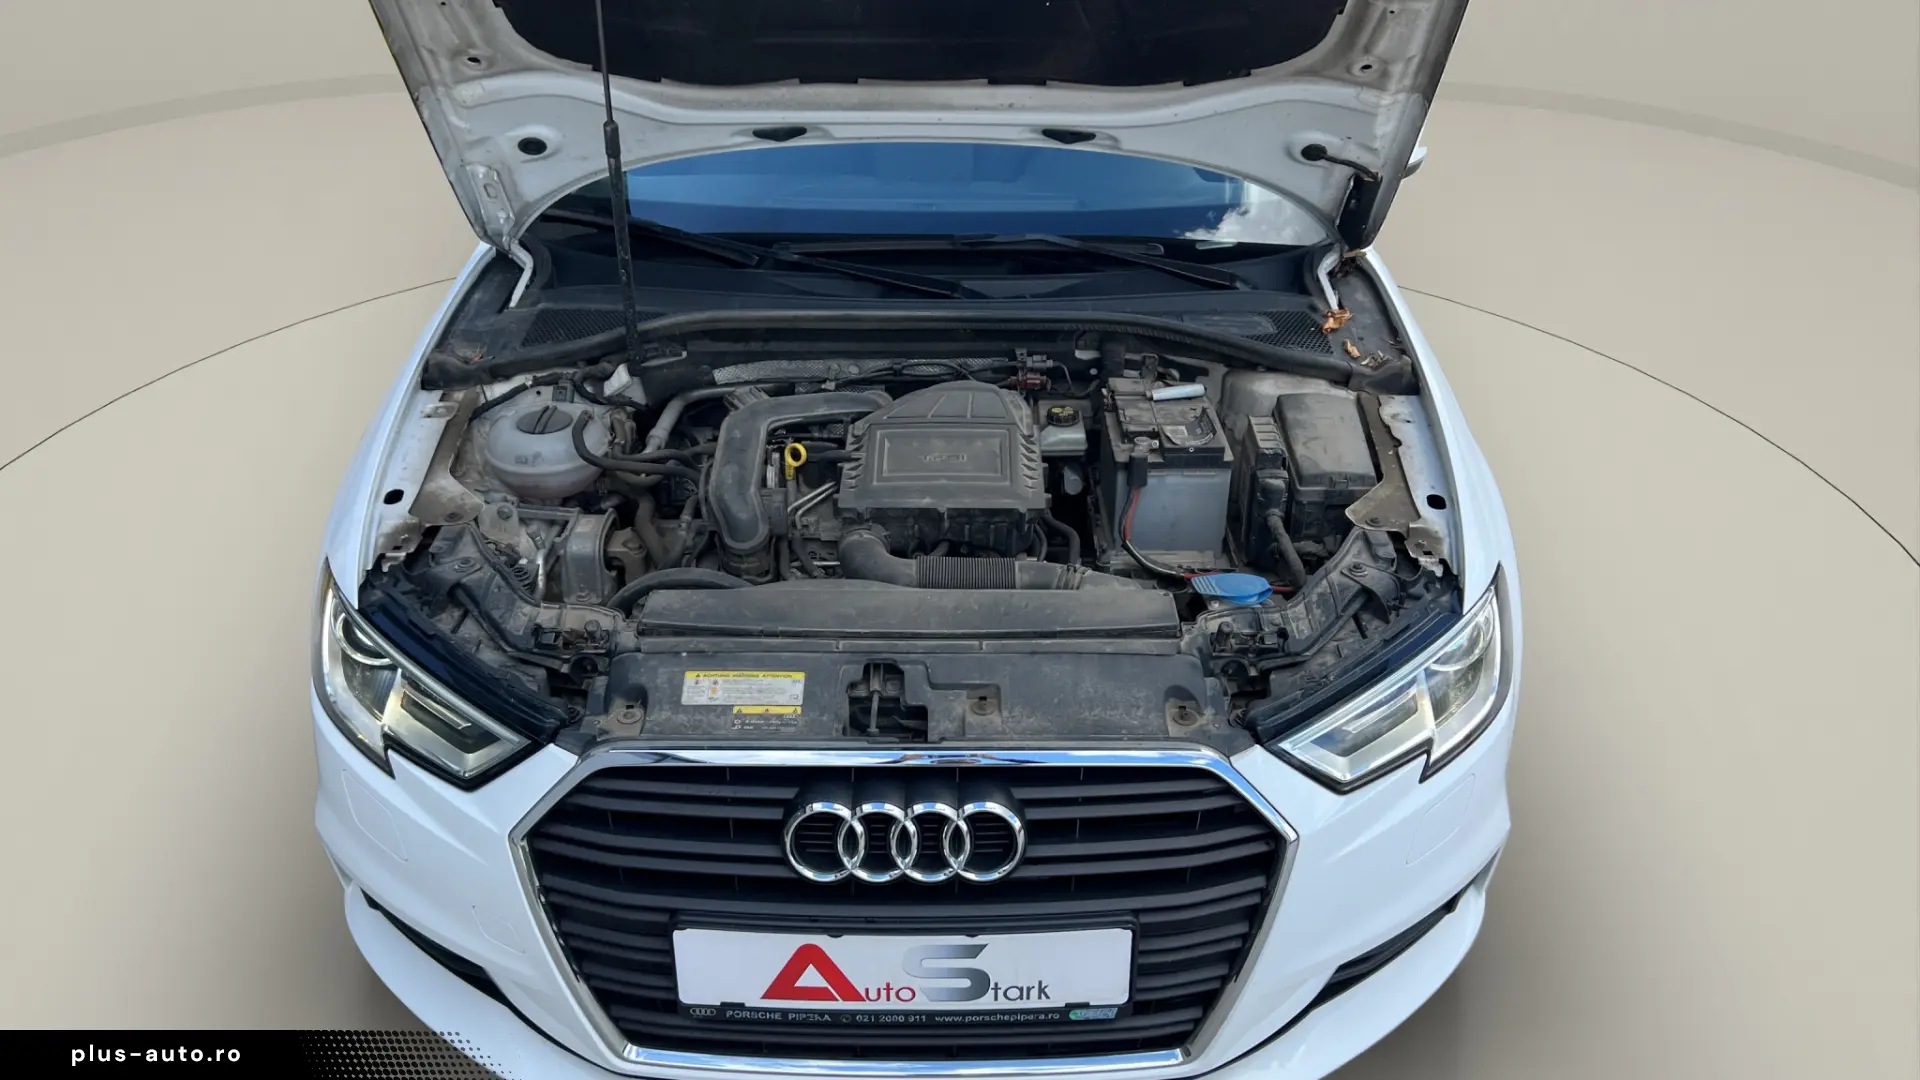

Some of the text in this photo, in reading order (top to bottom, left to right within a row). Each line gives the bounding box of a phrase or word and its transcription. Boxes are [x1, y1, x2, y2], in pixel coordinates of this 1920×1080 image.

[726, 1010, 783, 1020] PORSCHE
[856, 1014, 875, 1023] 021
[908, 1014, 926, 1023] 911
